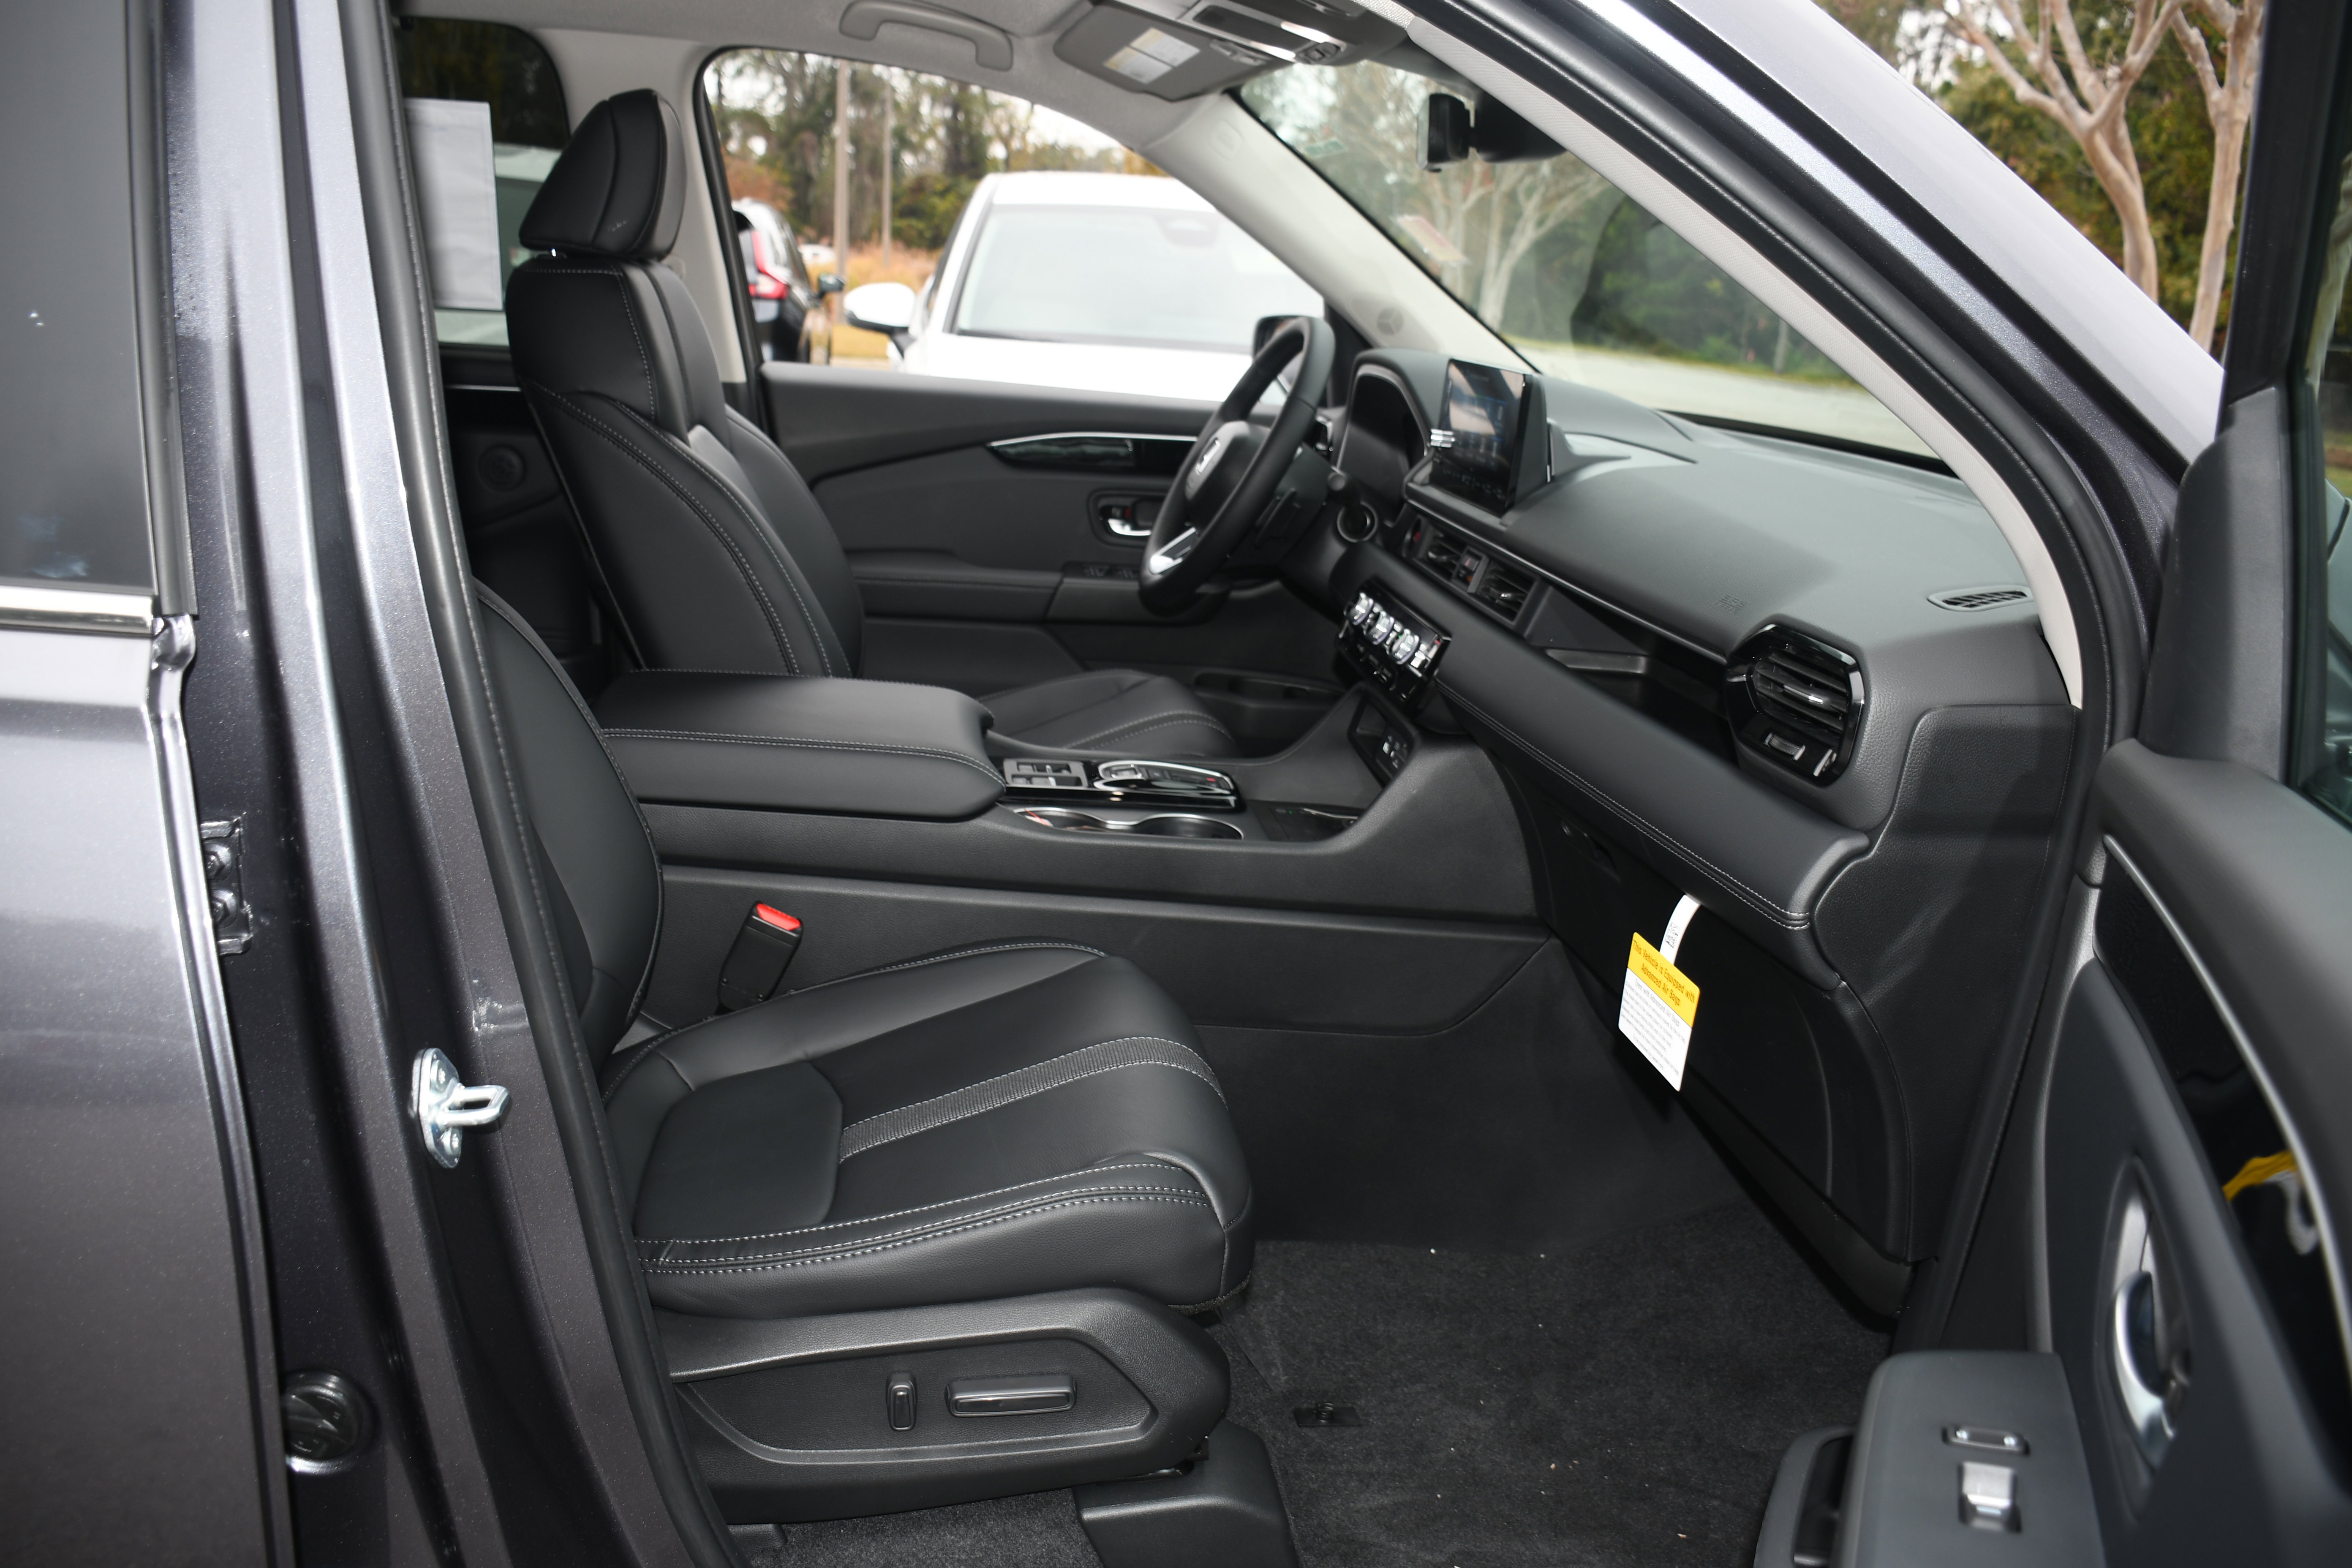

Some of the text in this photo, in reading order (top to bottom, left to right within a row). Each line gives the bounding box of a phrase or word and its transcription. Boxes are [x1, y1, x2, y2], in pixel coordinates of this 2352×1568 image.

[1633, 940, 1695, 1003] This Vehicle is Equipped with
[1641, 963, 1661, 988] Advanced
[1669, 989, 1680, 1006] Bags
